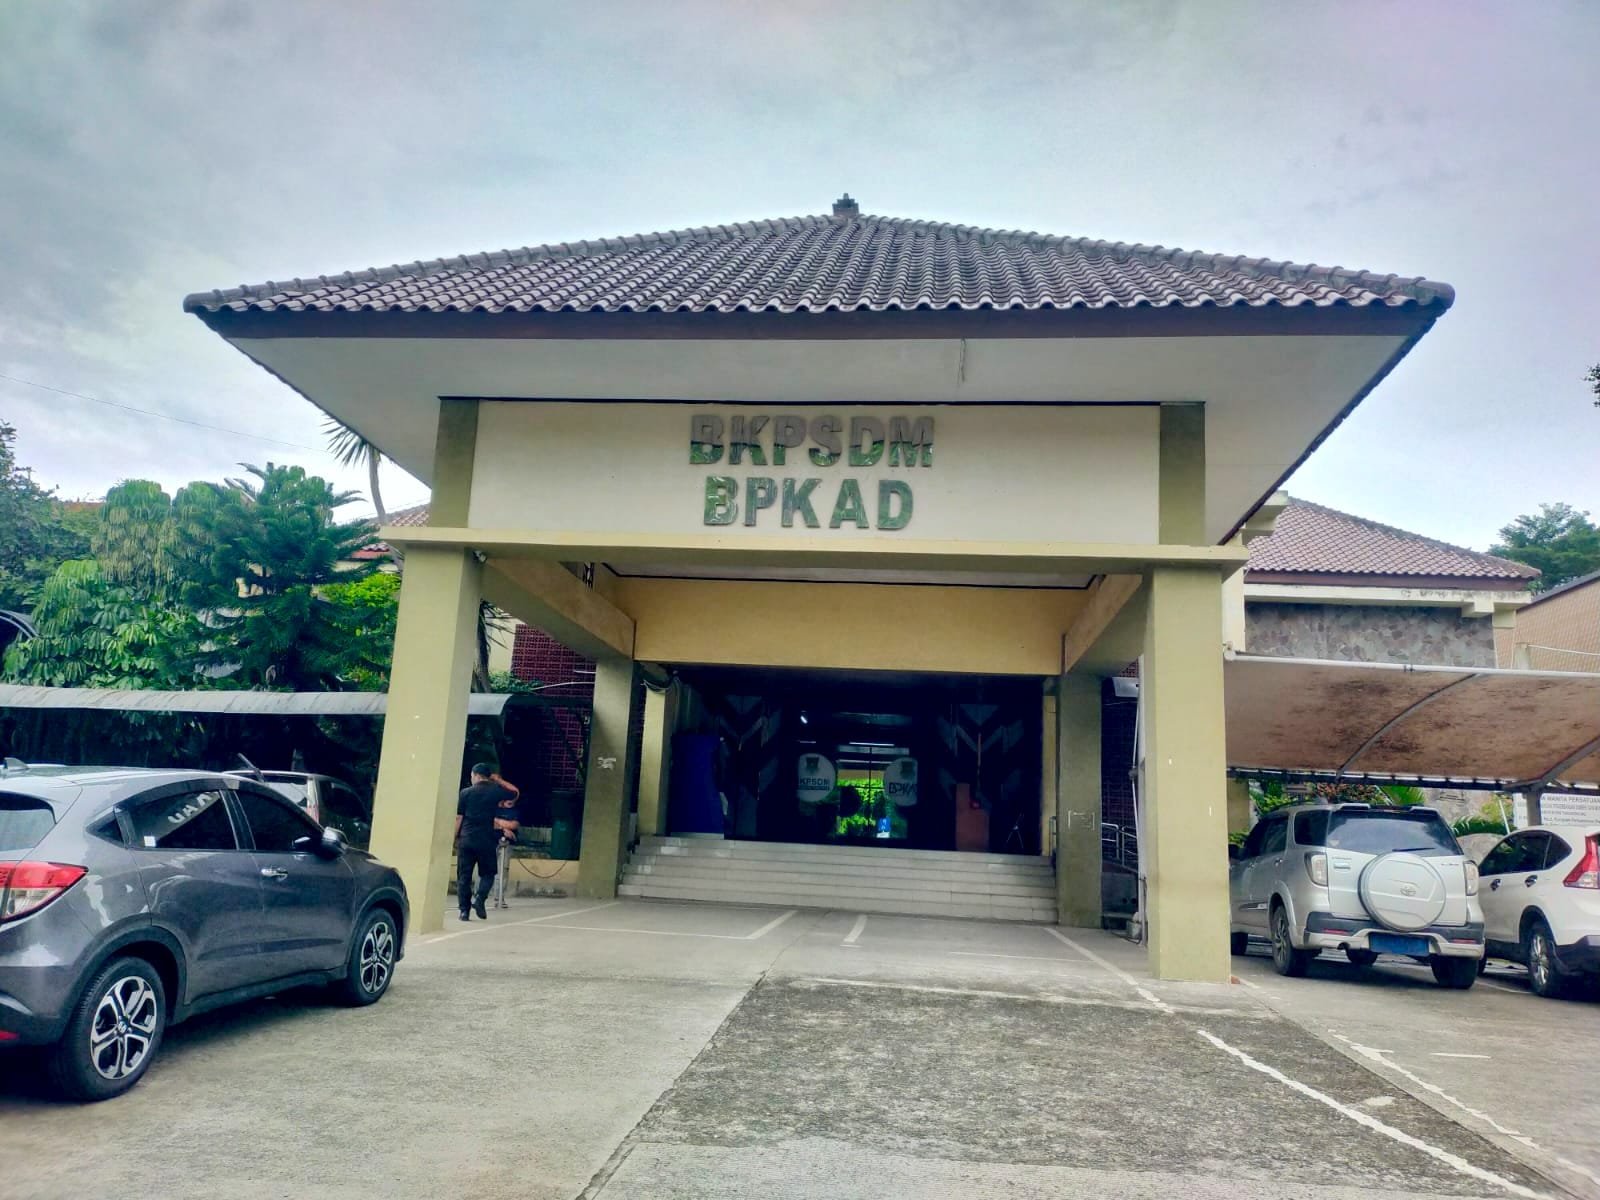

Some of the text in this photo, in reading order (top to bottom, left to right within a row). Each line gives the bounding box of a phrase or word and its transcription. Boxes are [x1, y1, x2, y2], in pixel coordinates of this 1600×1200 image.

[689, 414, 935, 467] BKPSDM
[703, 475, 914, 530] BPKAD
[800, 778, 830, 786] KPSDM
[889, 782, 917, 795] BPKA
